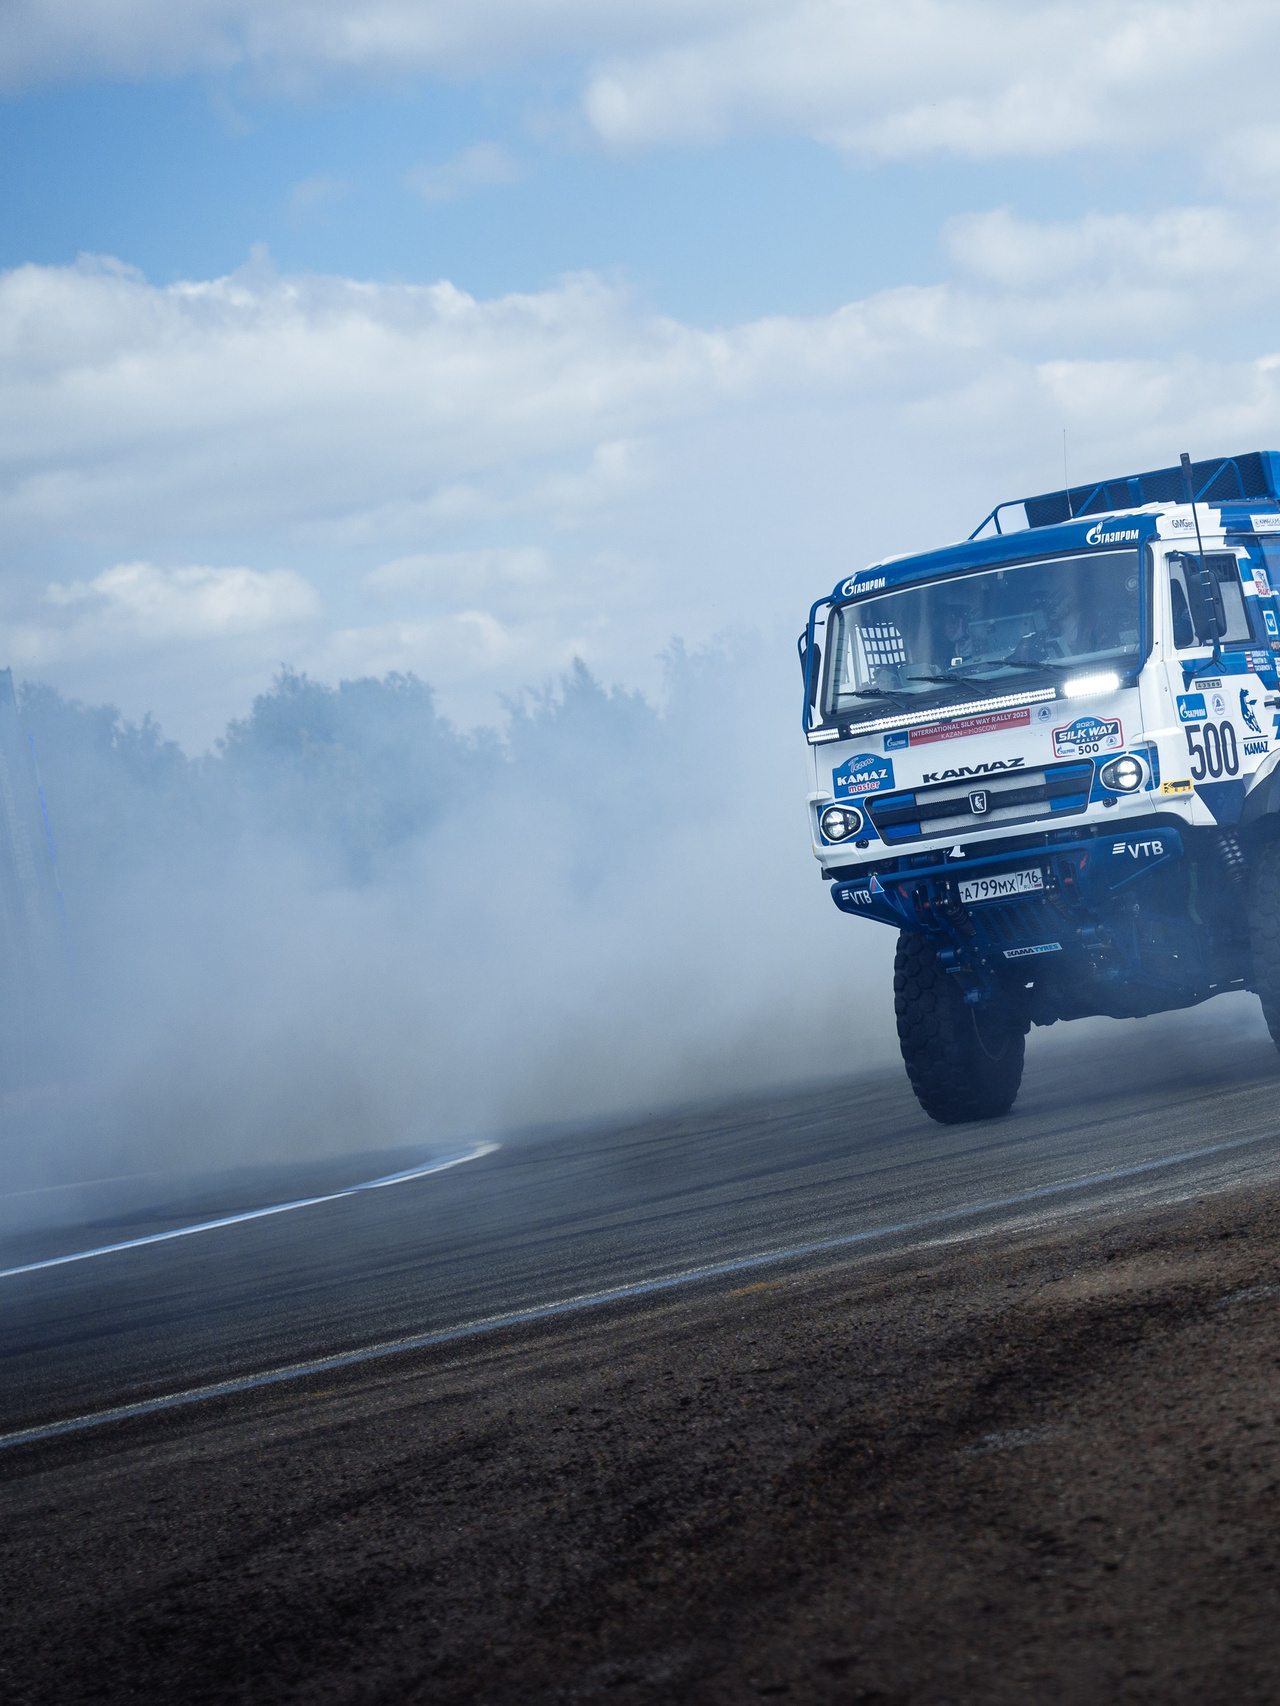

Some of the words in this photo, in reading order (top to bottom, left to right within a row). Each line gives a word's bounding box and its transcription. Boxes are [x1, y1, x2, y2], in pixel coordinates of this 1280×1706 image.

[911, 723, 960, 738] INTERNATIONAL
[960, 719, 975, 729] SILK
[976, 717, 991, 726] WAY
[991, 714, 1012, 724] RALLY
[1012, 711, 1028, 720] 2023
[941, 731, 963, 740] KAZAN
[968, 724, 997, 735] MOSCOW
[1076, 721, 1095, 729] 2023
[1058, 728, 1087, 742] SILK
[1088, 724, 1116, 737] WAY
[1076, 736, 1099, 744] RALLY
[1078, 743, 1099, 755] 500
[1185, 720, 1239, 781] 500
[1243, 741, 1270, 756] KAMAZ
[848, 757, 875, 773] Team
[923, 757, 1025, 783] KAMAZ
[837, 768, 889, 786] KAMAZ
[848, 781, 880, 793] master
[1127, 840, 1164, 859] VTB
[1017, 871, 1039, 886] 716
[849, 889, 873, 905] VTB
